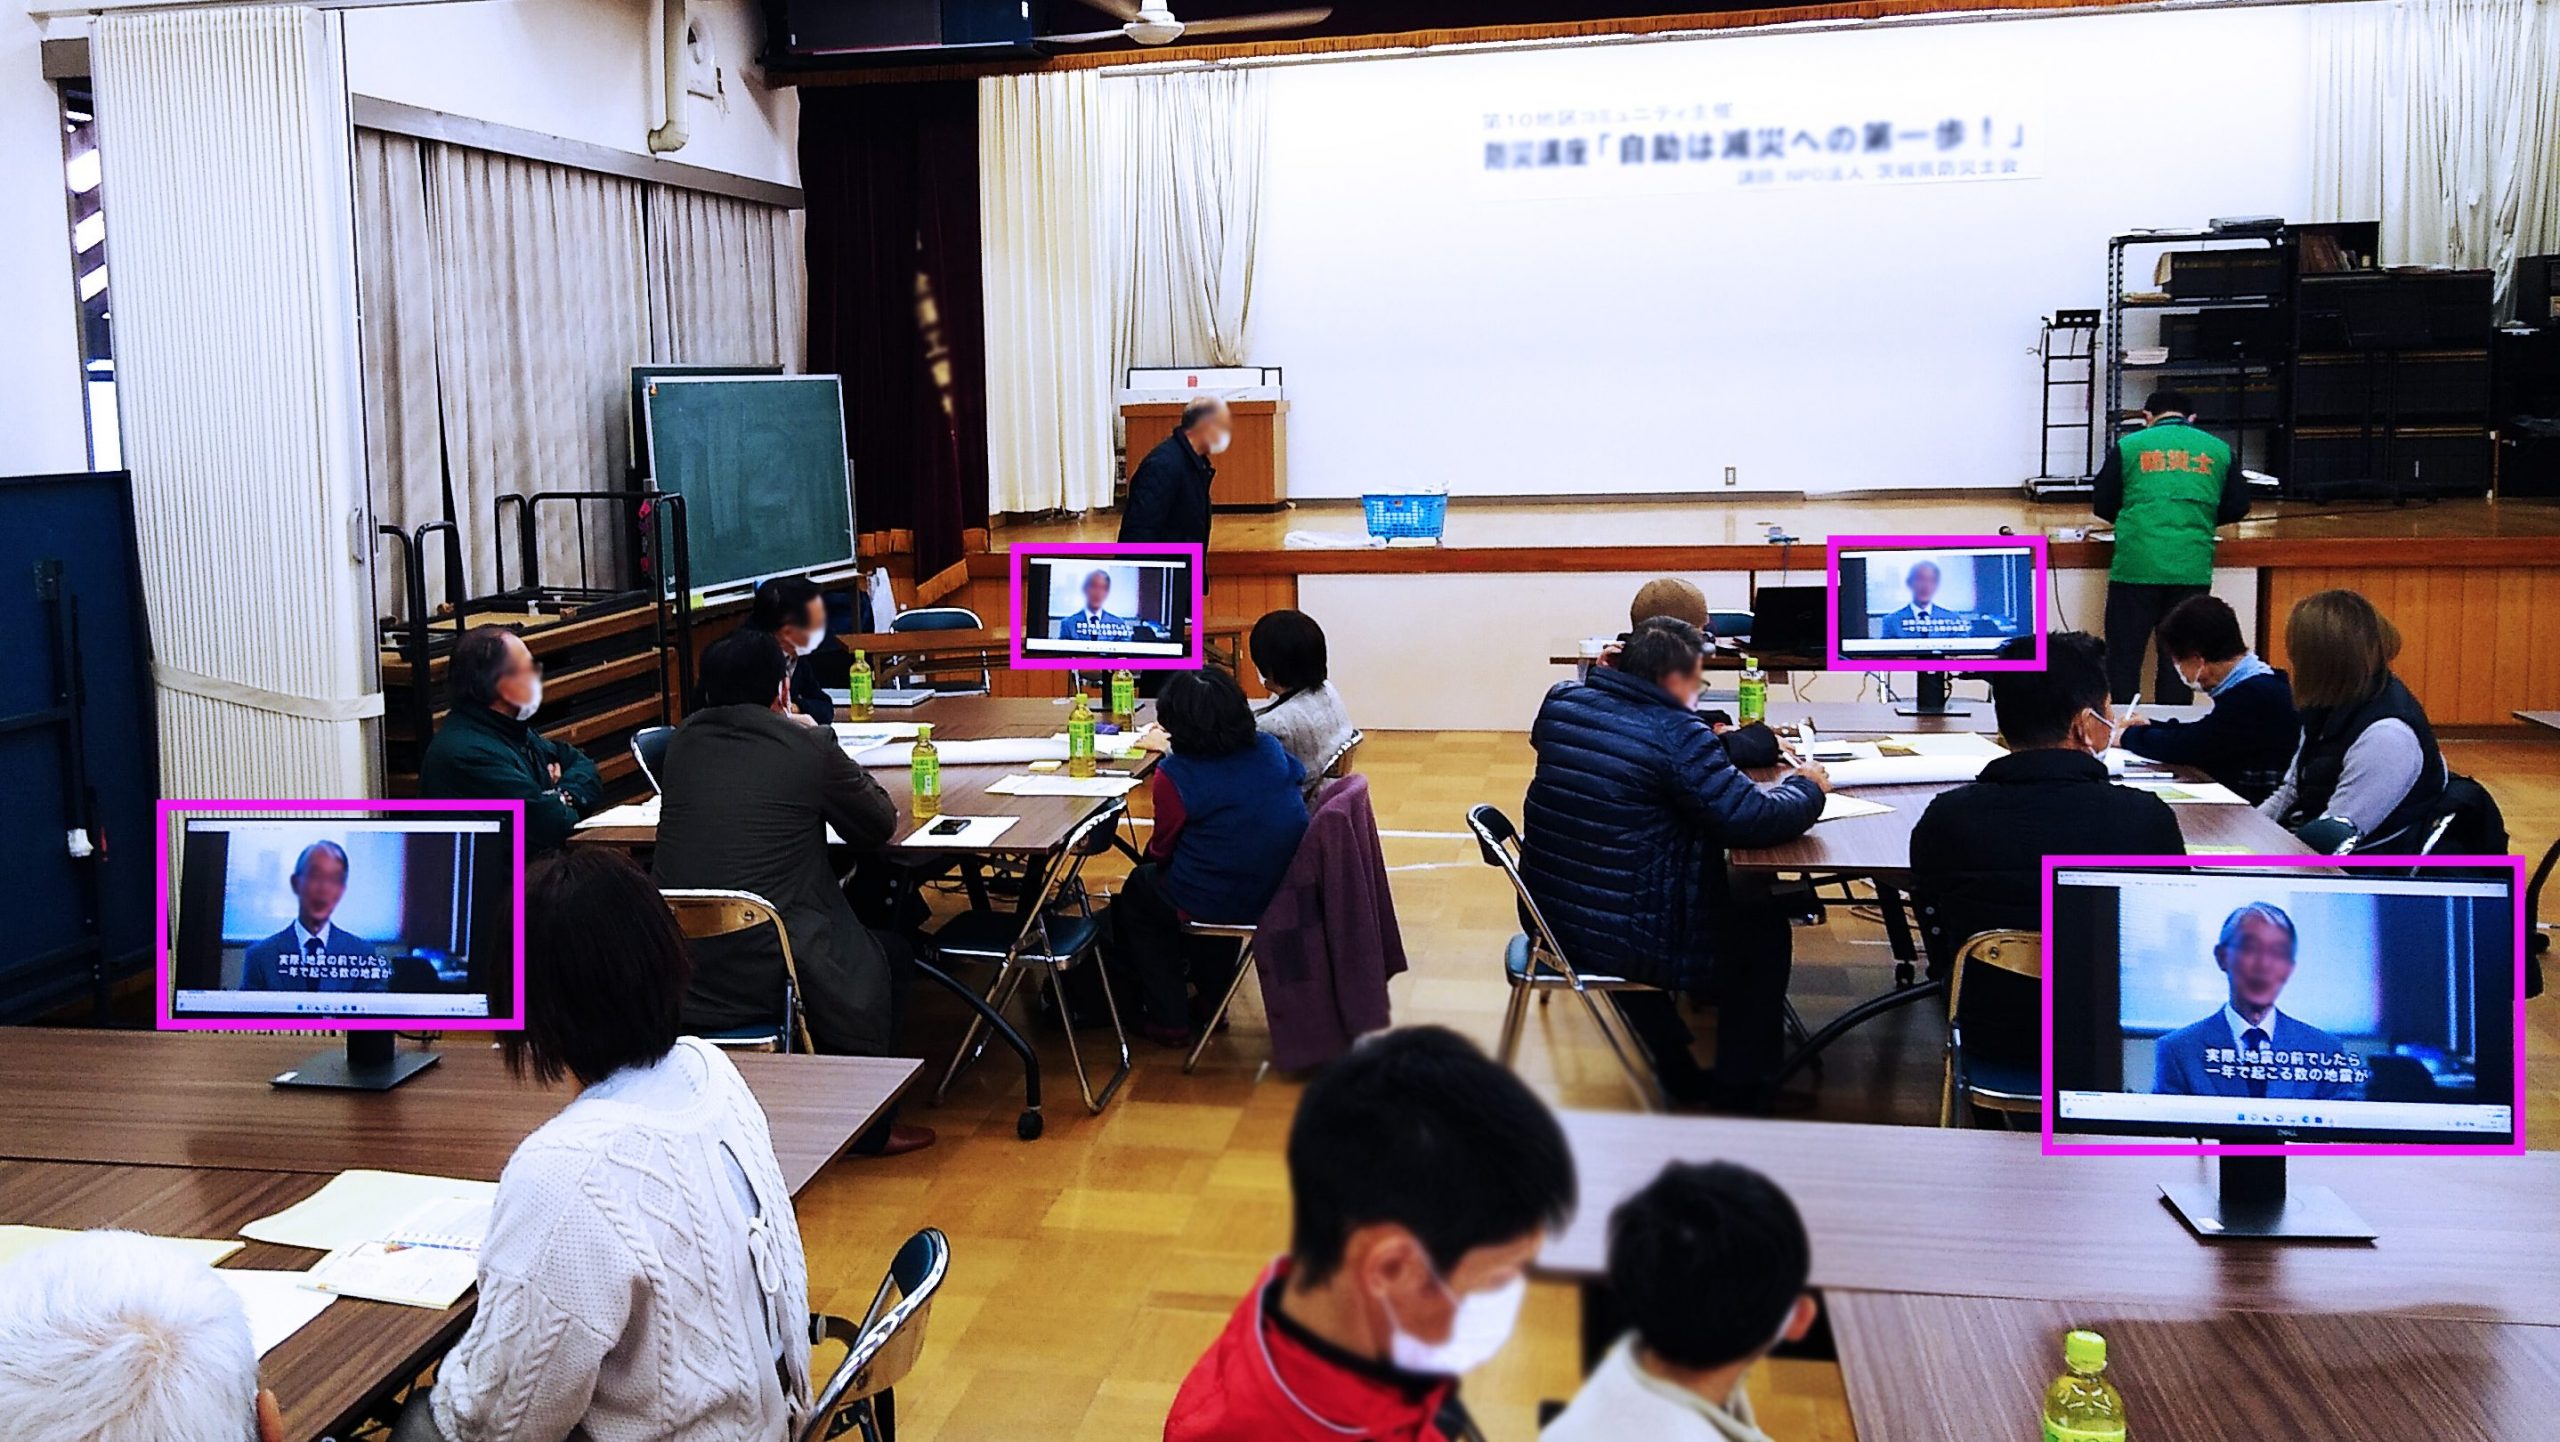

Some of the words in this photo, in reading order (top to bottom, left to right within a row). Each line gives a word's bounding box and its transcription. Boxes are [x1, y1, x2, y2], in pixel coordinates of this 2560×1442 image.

[2205, 1064, 2369, 1083] 一年で起こる数の地震が
